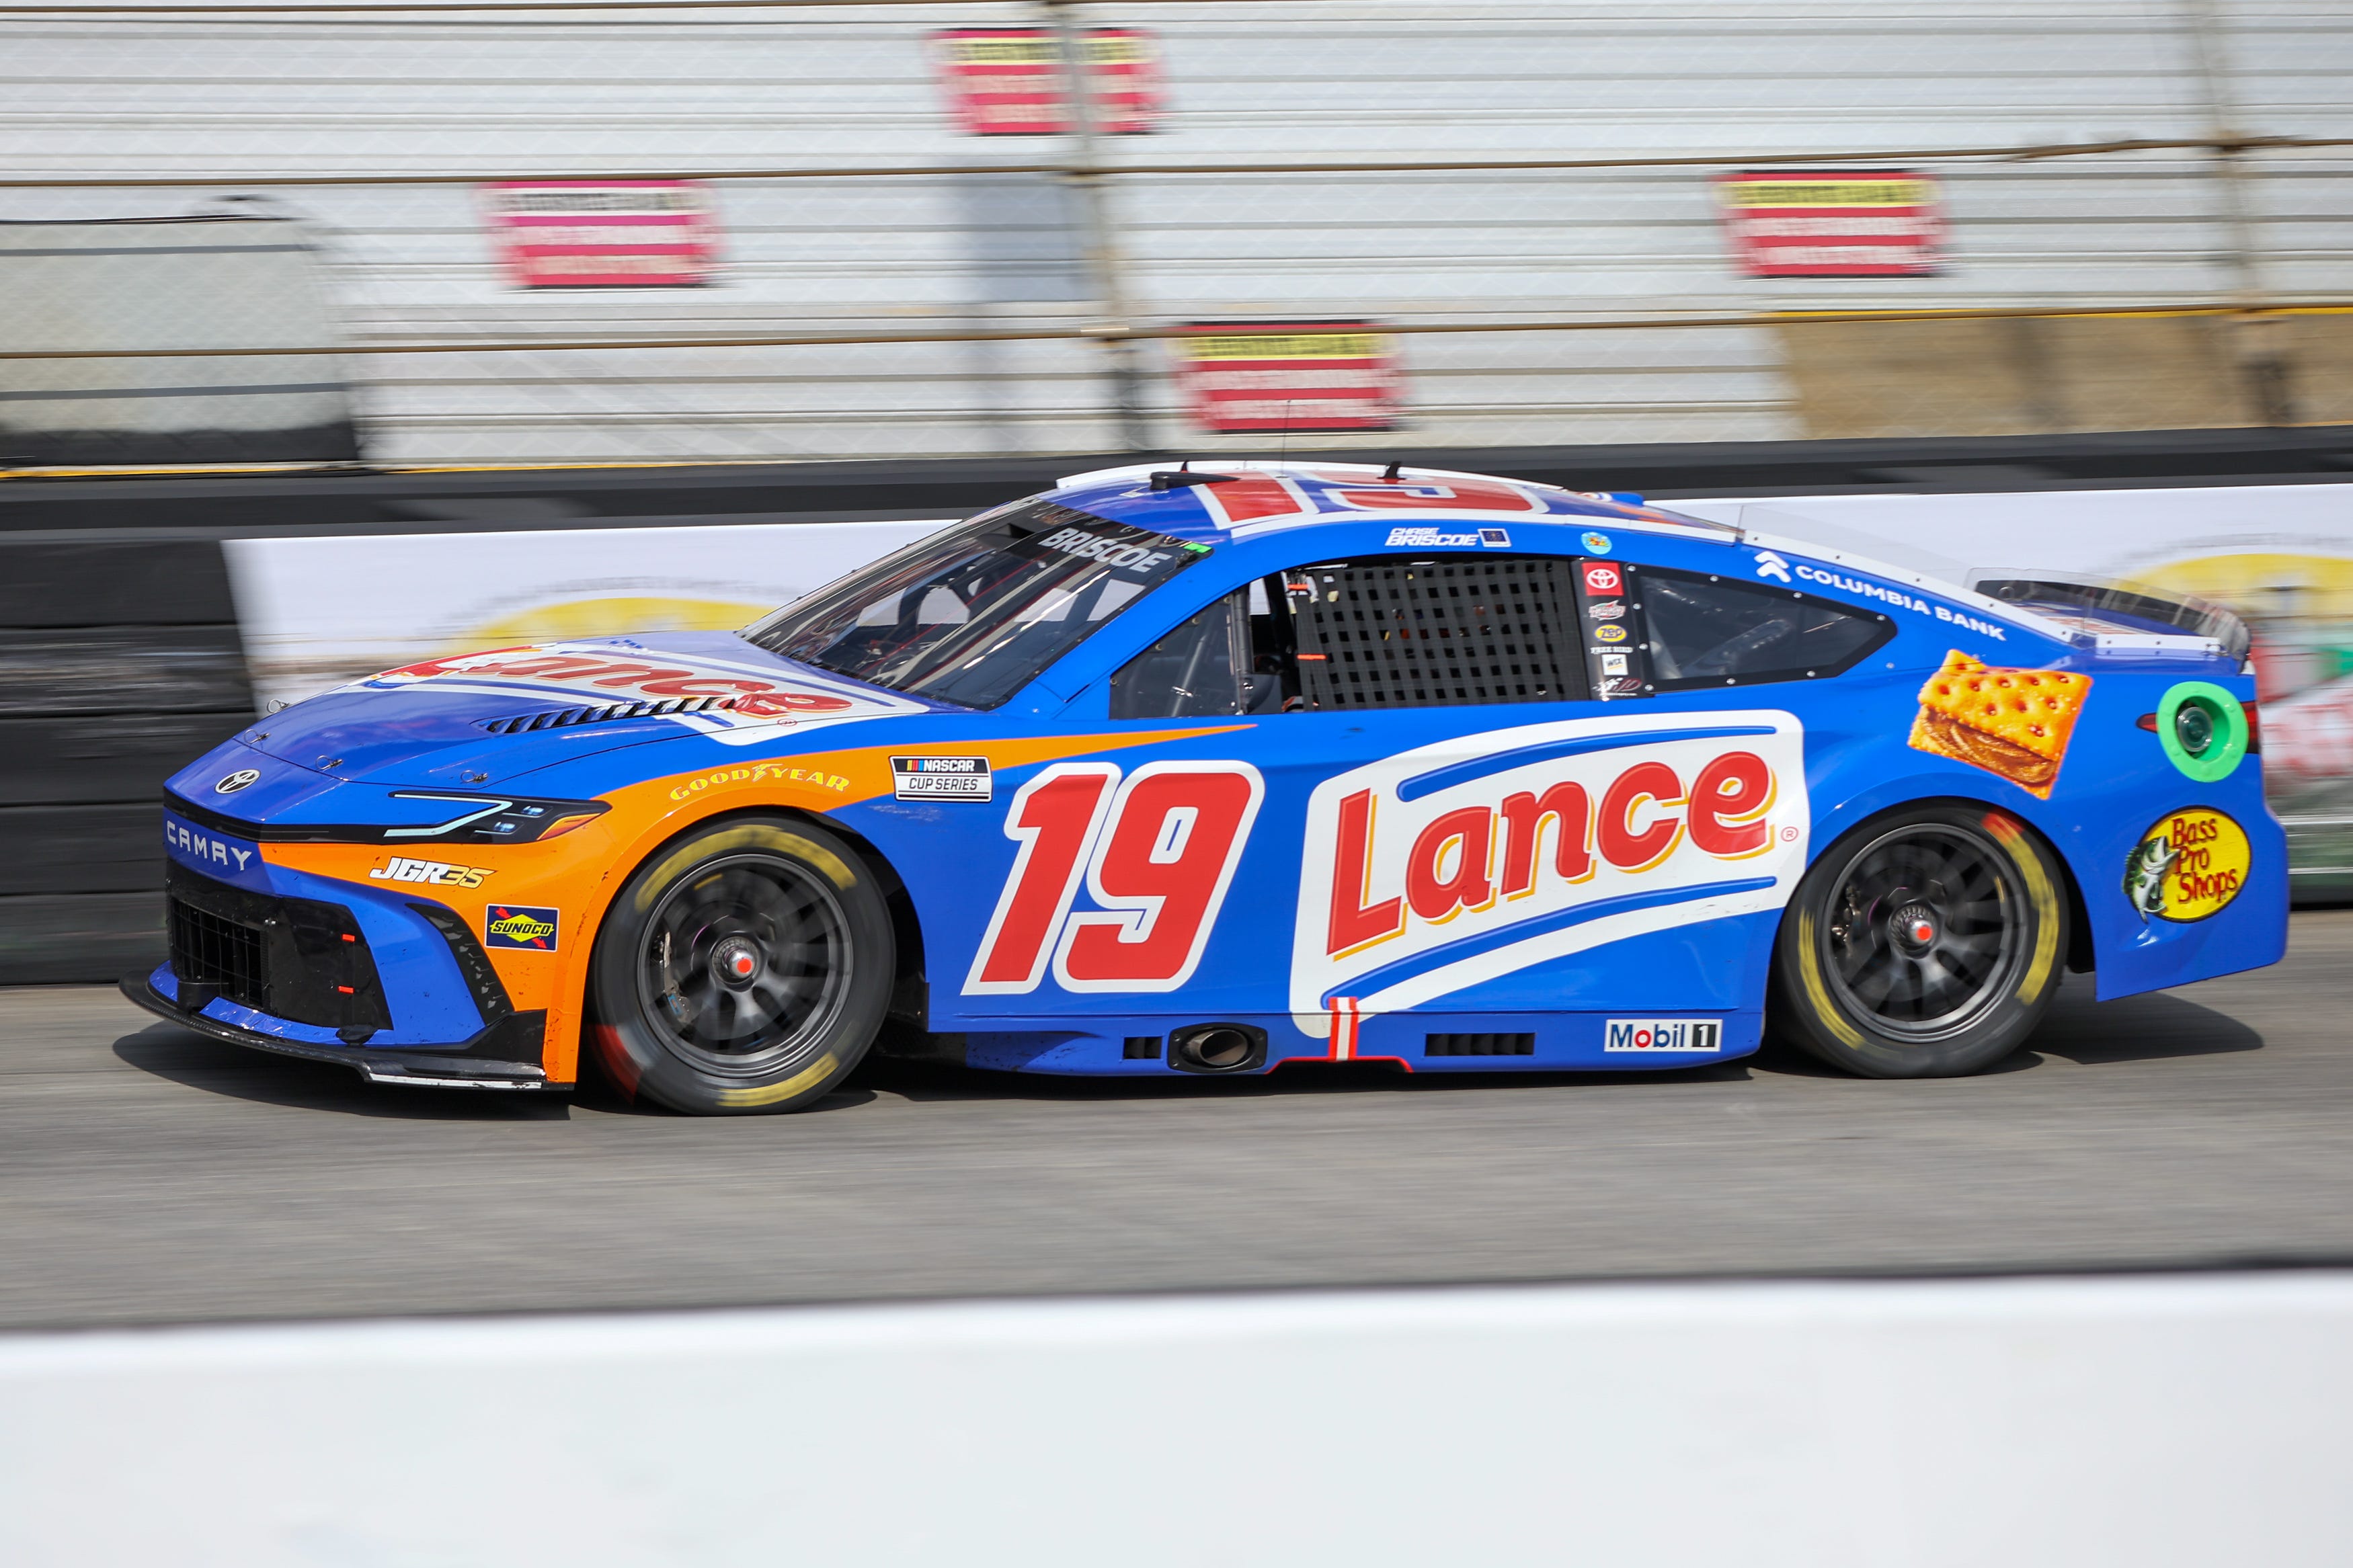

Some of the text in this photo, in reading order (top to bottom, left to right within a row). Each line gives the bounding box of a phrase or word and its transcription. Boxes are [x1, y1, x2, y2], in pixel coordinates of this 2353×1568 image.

[1384, 534, 1480, 546] BRISCOE
[1390, 527, 1440, 535] CHASE
[1038, 528, 1172, 573] BRISCOE
[1794, 565, 1931, 616] COLUMBIA
[1934, 606, 2007, 641] BANK
[370, 645, 853, 719] Lance
[923, 759, 975, 772] NASCAR
[669, 764, 850, 801] GOODYEAR
[909, 777, 979, 791] CUP SERIES
[166, 820, 253, 872] CAMRY
[2171, 817, 2217, 848] Bass
[1327, 751, 1776, 961] Lance
[2173, 845, 2210, 874] Pro
[963, 761, 1264, 992] 19
[2177, 868, 2238, 904] Shops
[493, 921, 552, 936] SUNOCO
[1609, 1023, 1714, 1048] Mobil 1
